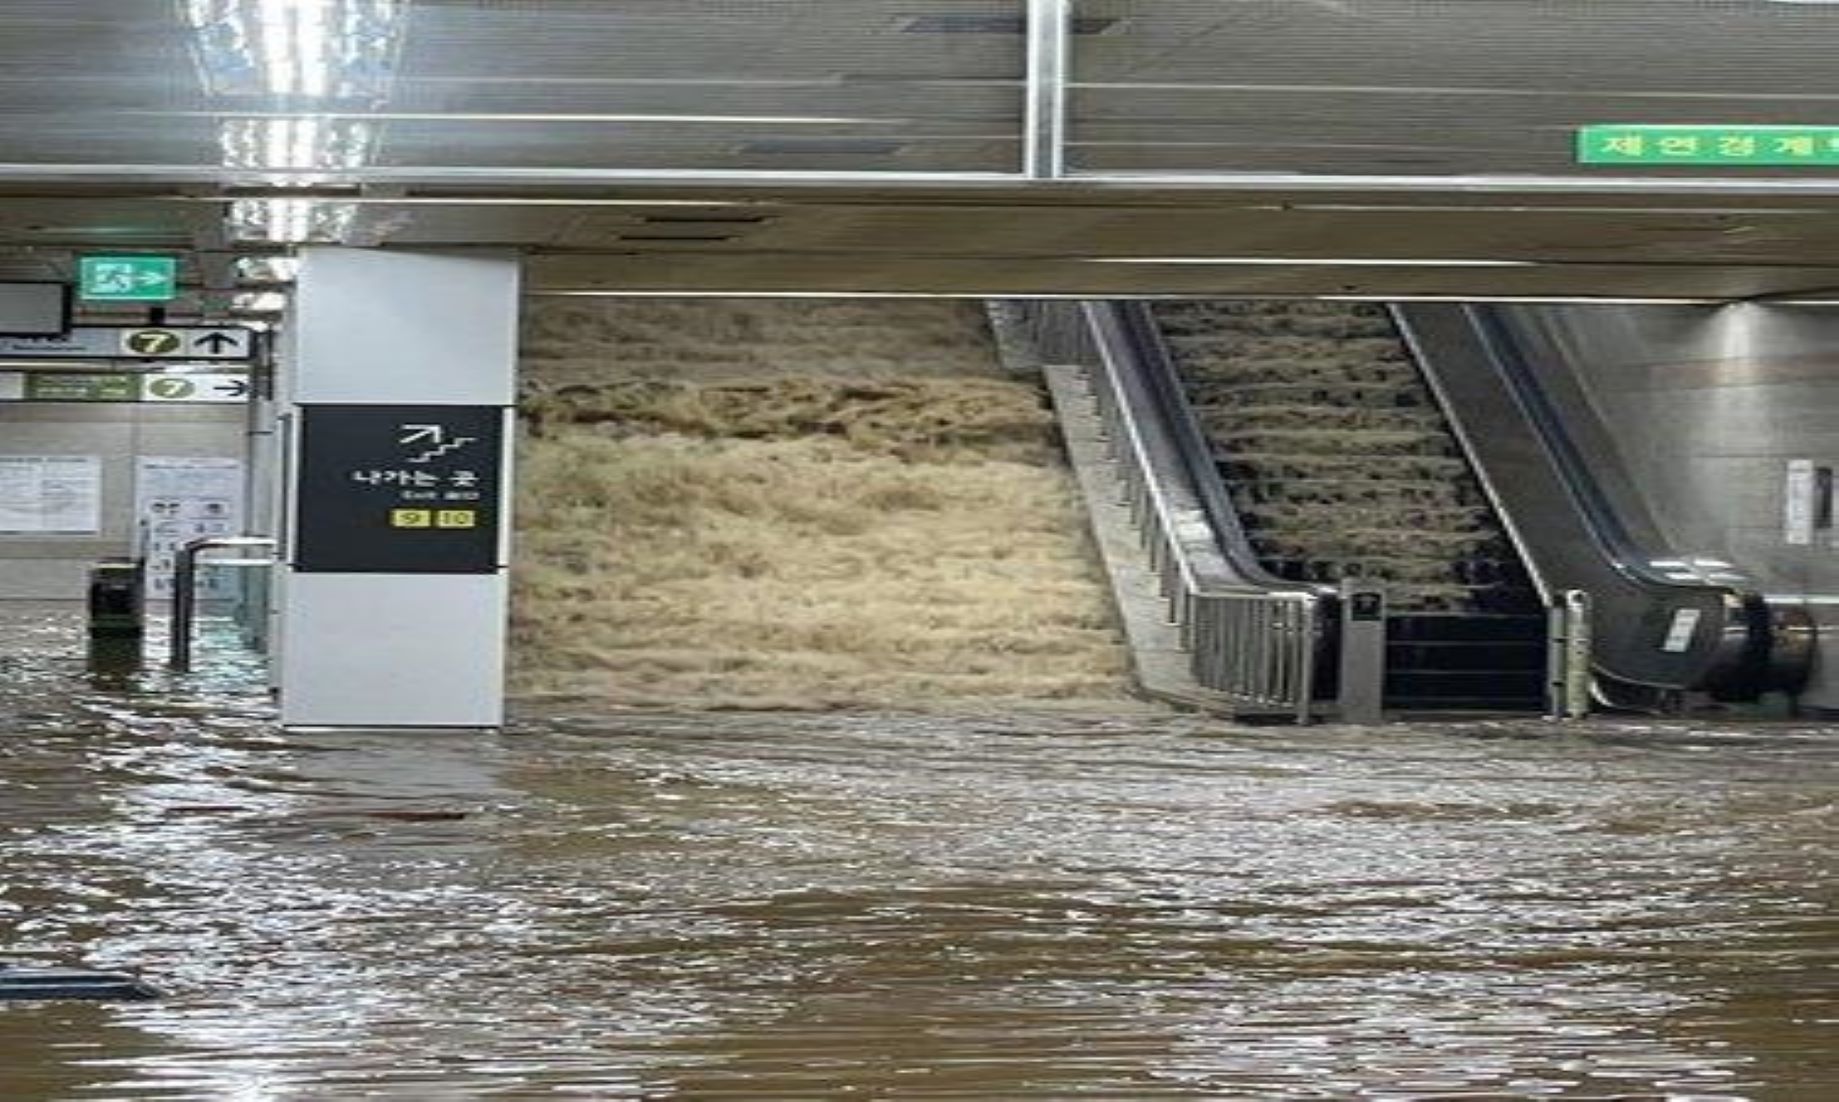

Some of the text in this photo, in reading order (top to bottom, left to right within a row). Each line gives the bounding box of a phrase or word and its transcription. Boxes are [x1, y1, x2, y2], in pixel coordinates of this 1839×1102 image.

[352, 470, 480, 487] 나가는 곳
[443, 511, 469, 525] 10
